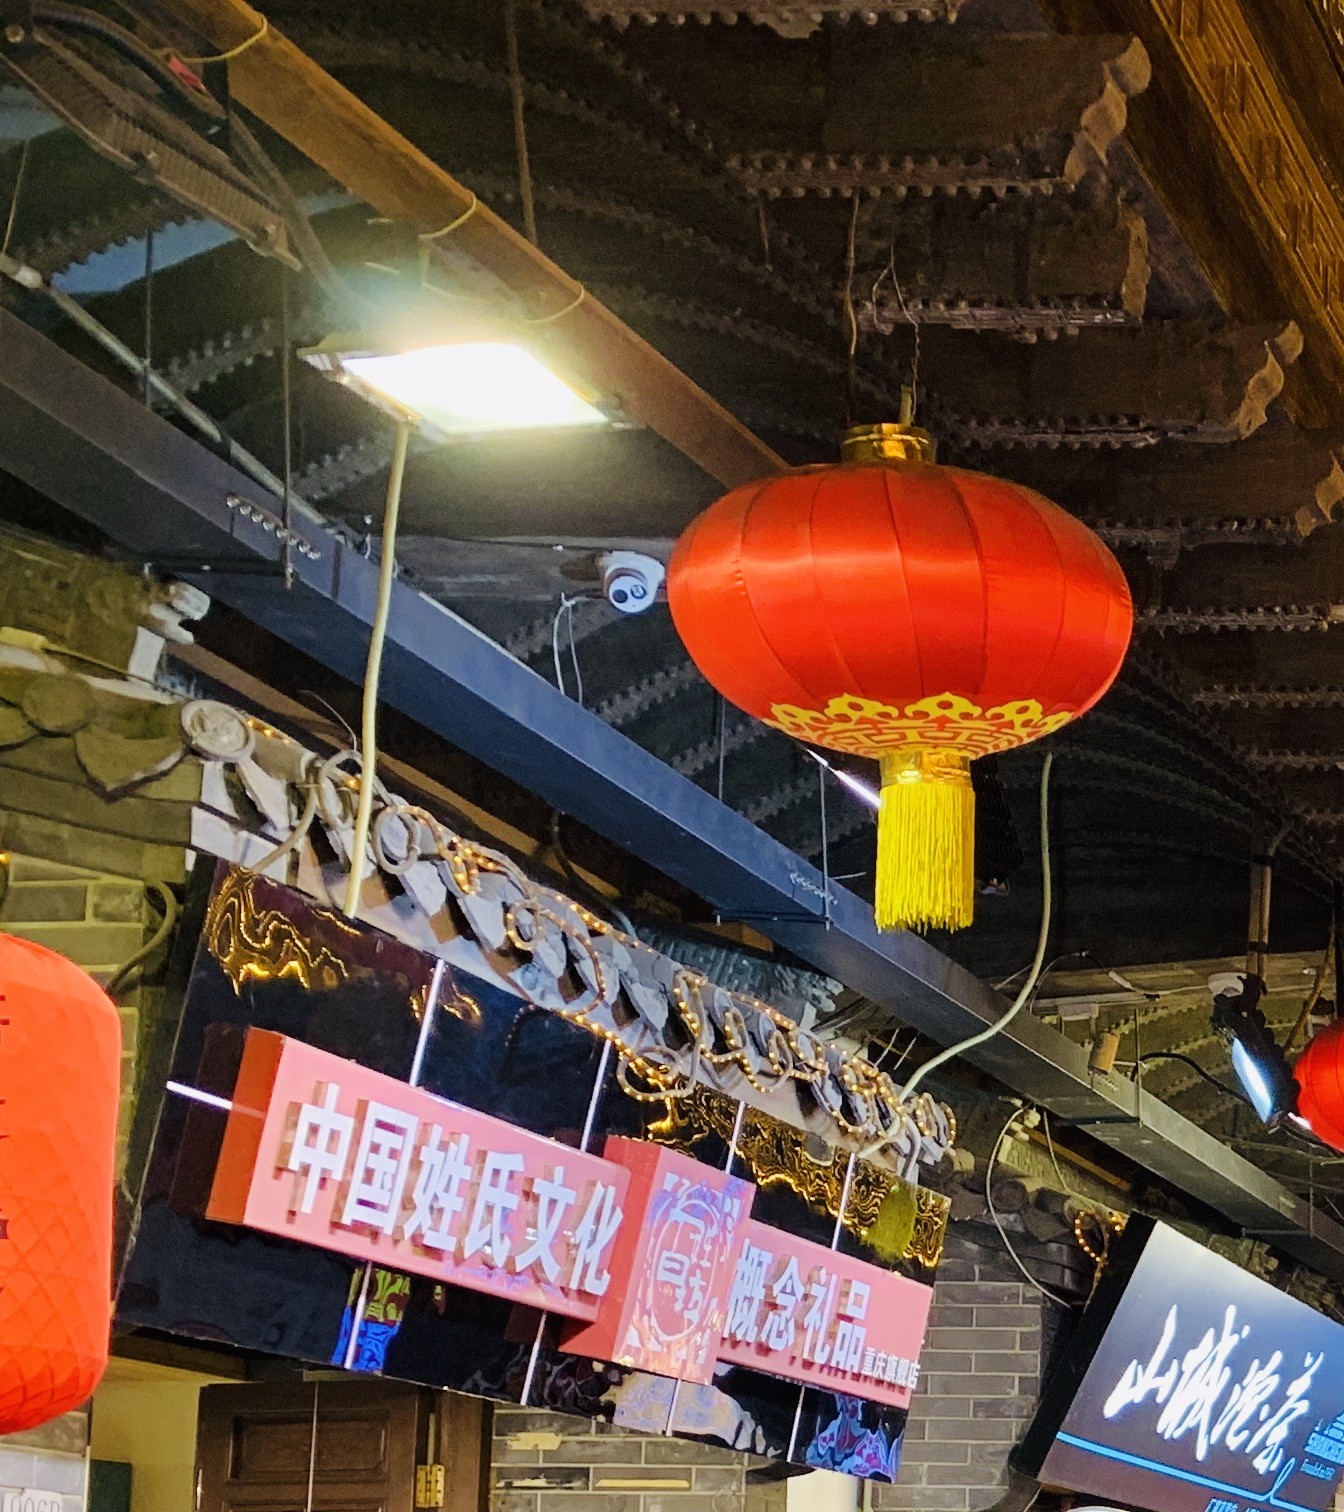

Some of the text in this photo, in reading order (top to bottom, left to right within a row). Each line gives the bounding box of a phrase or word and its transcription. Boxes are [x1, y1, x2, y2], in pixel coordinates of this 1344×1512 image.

[285, 1083, 626, 1299] 中国姓氏文化
[723, 1237, 871, 1375] 概念礼品
[861, 1346, 922, 1391] 重庆旗舰店
